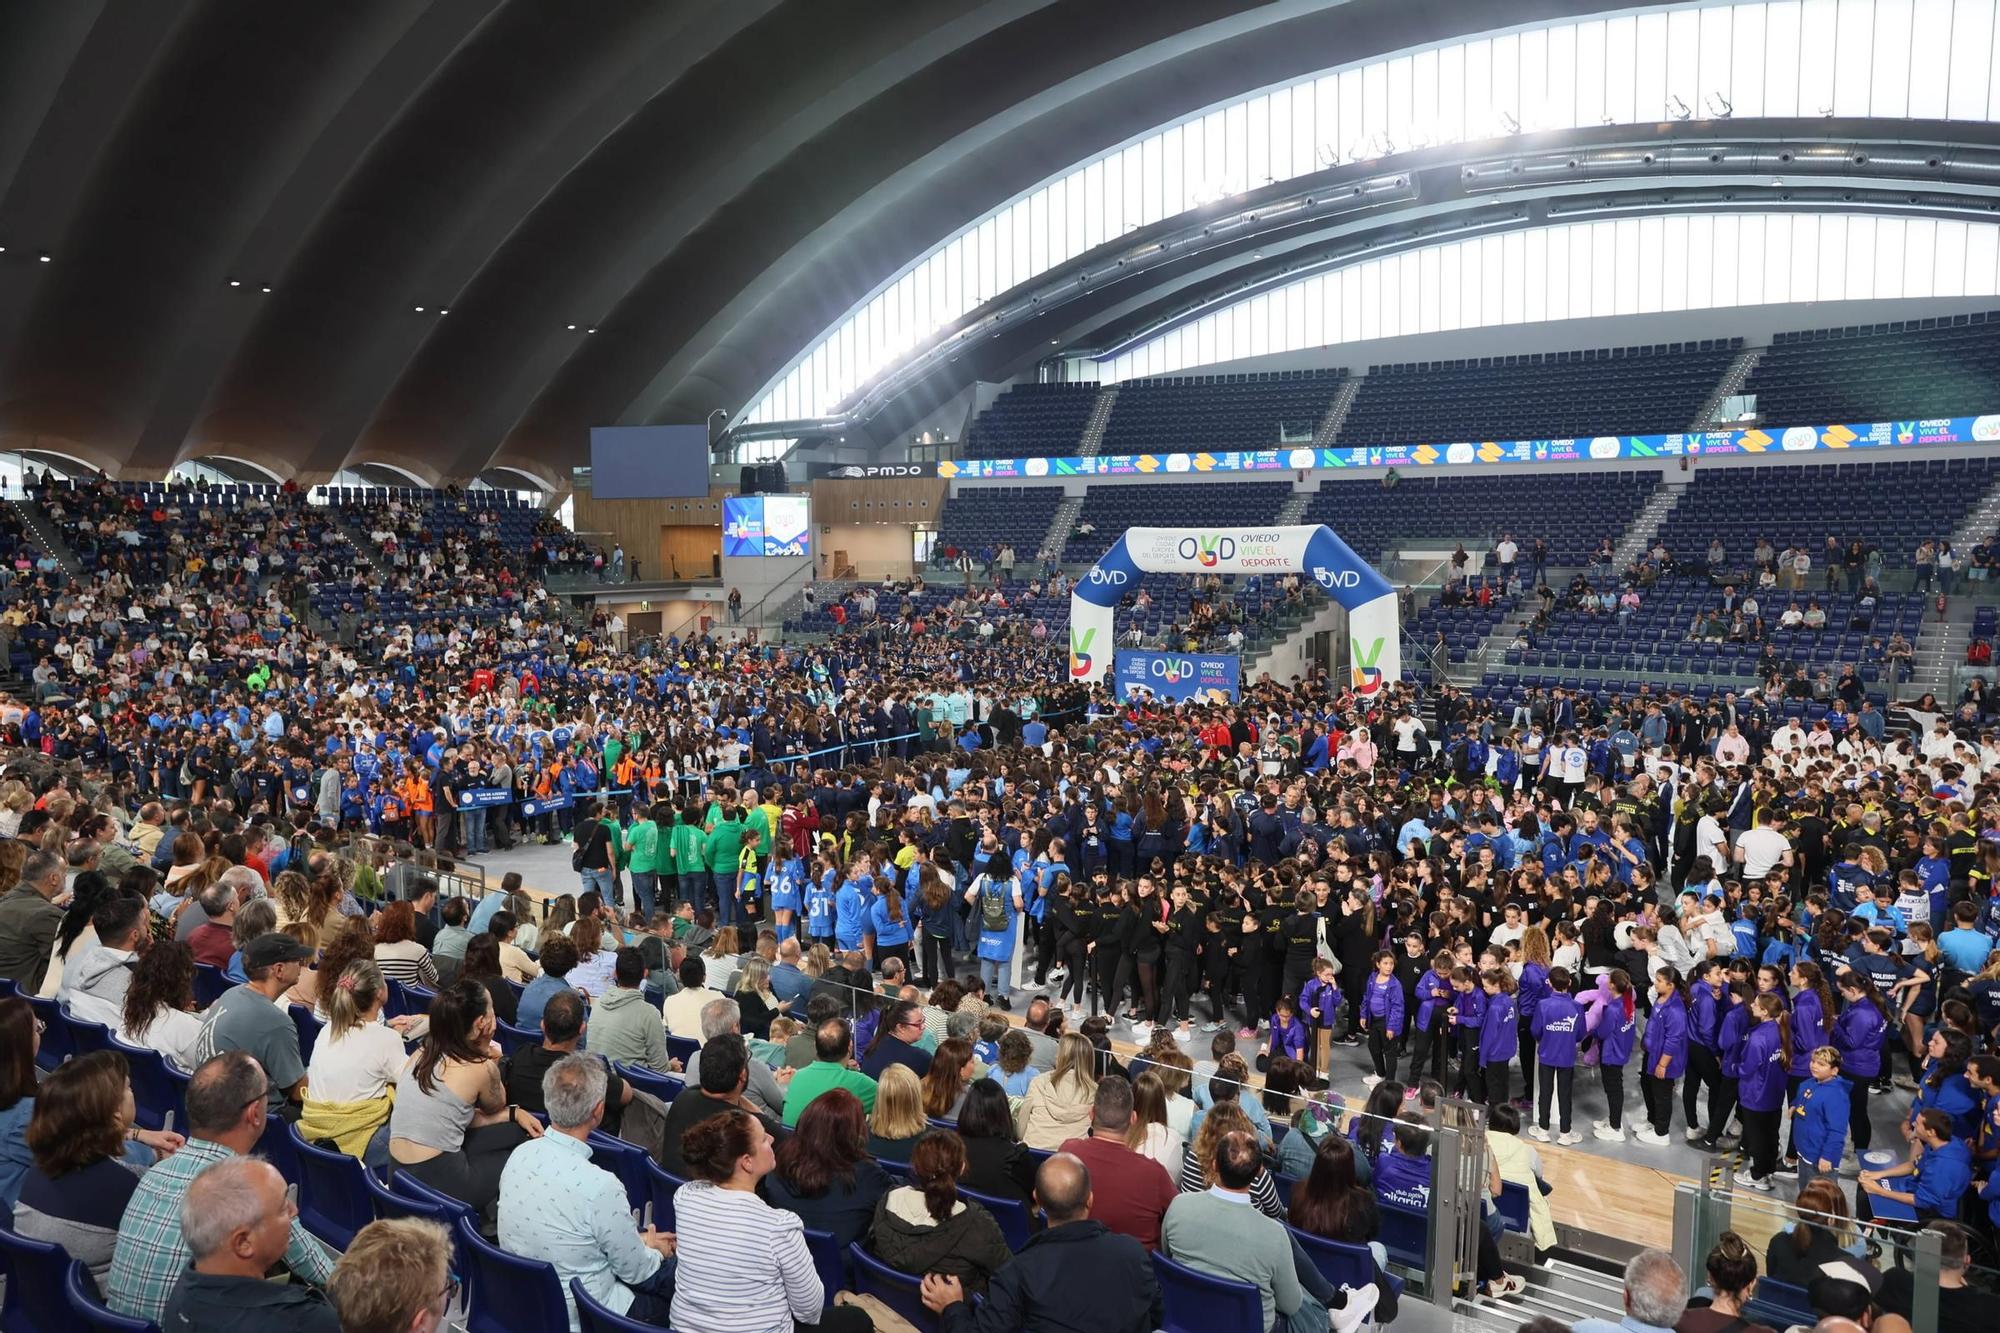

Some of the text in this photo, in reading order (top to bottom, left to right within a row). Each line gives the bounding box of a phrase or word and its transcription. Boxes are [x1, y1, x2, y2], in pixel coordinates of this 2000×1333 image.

[1920, 419, 1950, 427] OVIEDO
[1918, 435, 1958, 443] DEPORTE
[867, 467, 922, 476] PMDO
[1240, 534, 1280, 543] OVIEDO
[1178, 534, 1236, 566] OVD
[1240, 546, 1276, 556] VIVE EL
[1241, 558, 1291, 567] DEPORTE
[1090, 569, 1128, 584] OVD
[1320, 570, 1360, 588] OVD
[1152, 657, 1194, 684] OVD
[770, 876, 792, 894] 26
[810, 897, 828, 916] 31
